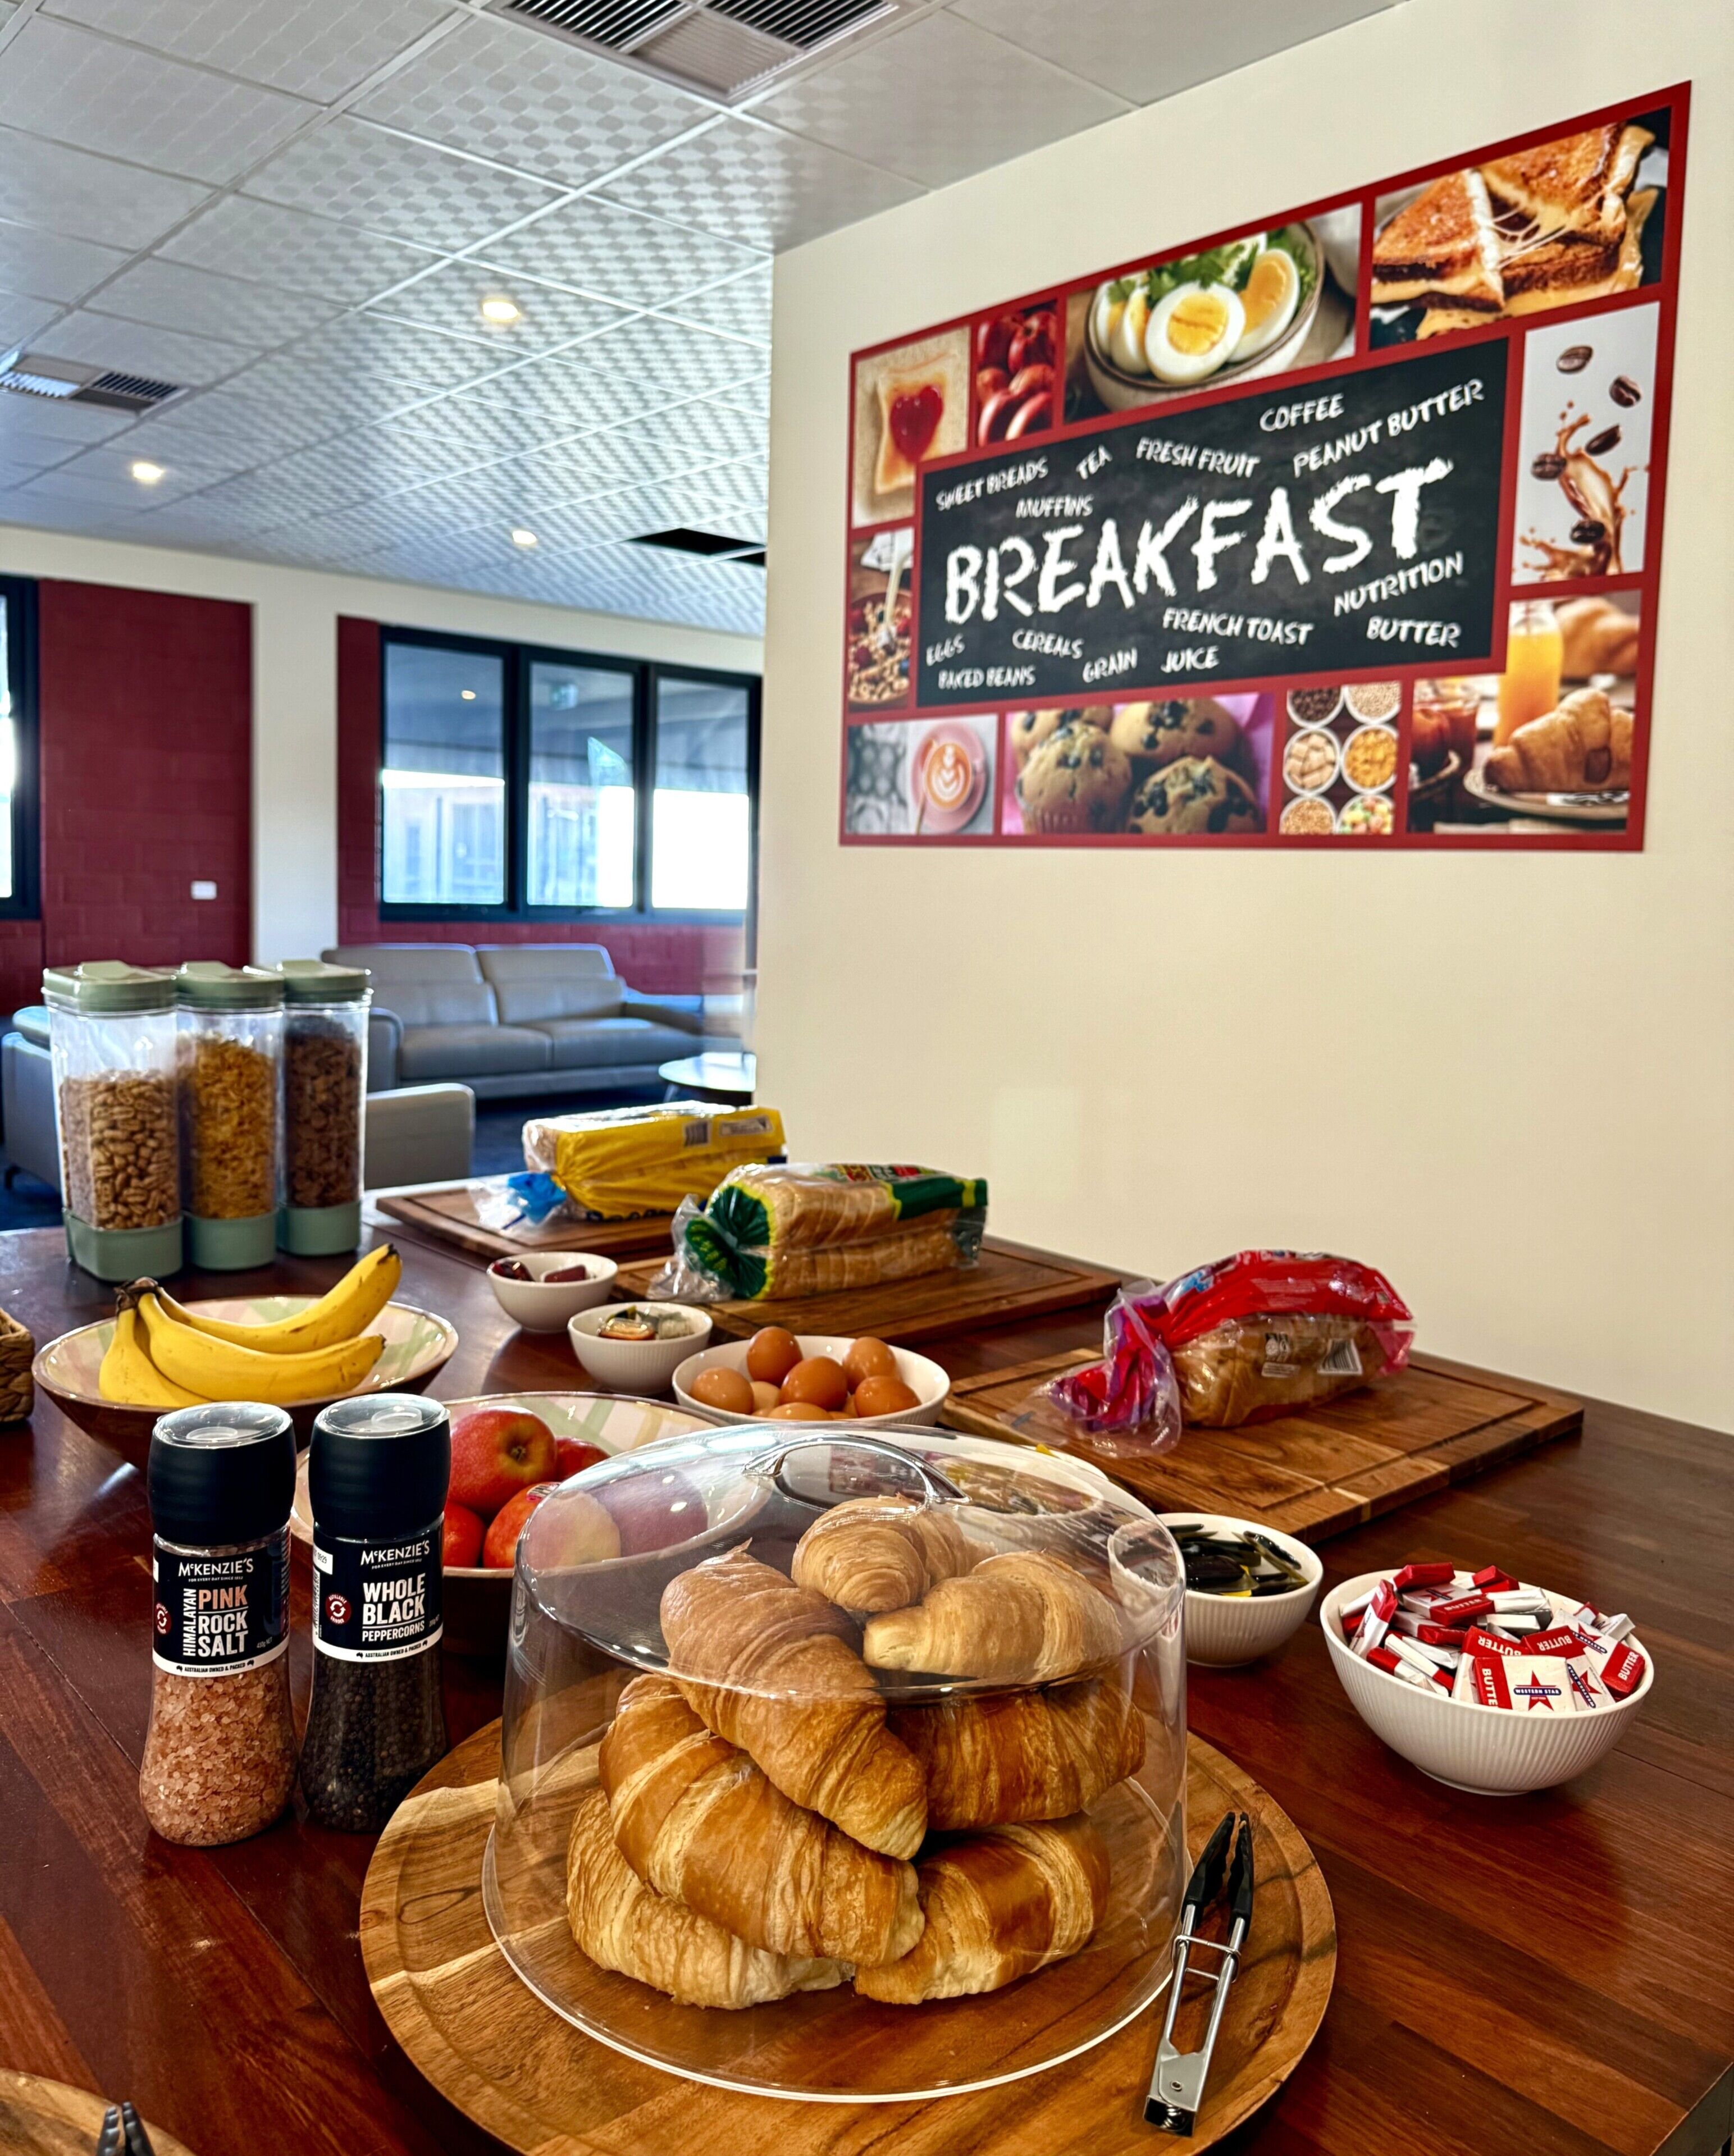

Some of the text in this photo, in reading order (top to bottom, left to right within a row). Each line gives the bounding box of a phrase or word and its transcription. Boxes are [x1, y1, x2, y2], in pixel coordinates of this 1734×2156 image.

[1260, 393, 1344, 432] COFFEE
[1293, 378, 1484, 478] PEANUT BUTTER
[1076, 445, 1112, 480] TEA
[1136, 437, 1261, 478] FRESH FRUIT
[936, 456, 1048, 511] SWEET BREADS
[1015, 494, 1094, 518] MUFFINS
[944, 457, 1454, 625] BREAKFAST
[1334, 551, 1463, 617] NUTRITION
[1162, 606, 1314, 646] FRENCH TOAST
[1366, 615, 1461, 648] BUTTER
[926, 633, 965, 666] EGGS
[1012, 628, 1084, 660] CEREALS
[1160, 645, 1220, 673] JUICE
[938, 665, 1037, 689] BAKED BEANS
[1082, 647, 1138, 683] GRAIN
[198, 1584, 248, 1610] PINK
[363, 1573, 426, 1603] WHOLE
[182, 1588, 197, 1656] HIMALAYAN
[198, 1610, 248, 1634] ROCK
[363, 1593, 425, 1625] BLACK
[198, 1630, 248, 1657] SALT
[362, 1620, 425, 1642] PEPPERCORNS
[1477, 1635, 1522, 1656] BUTTER
[1536, 1635, 1572, 1651] BUTTER
[1617, 1651, 1639, 1681] BUTTER
[1482, 1668, 1498, 1706] BUTTE
